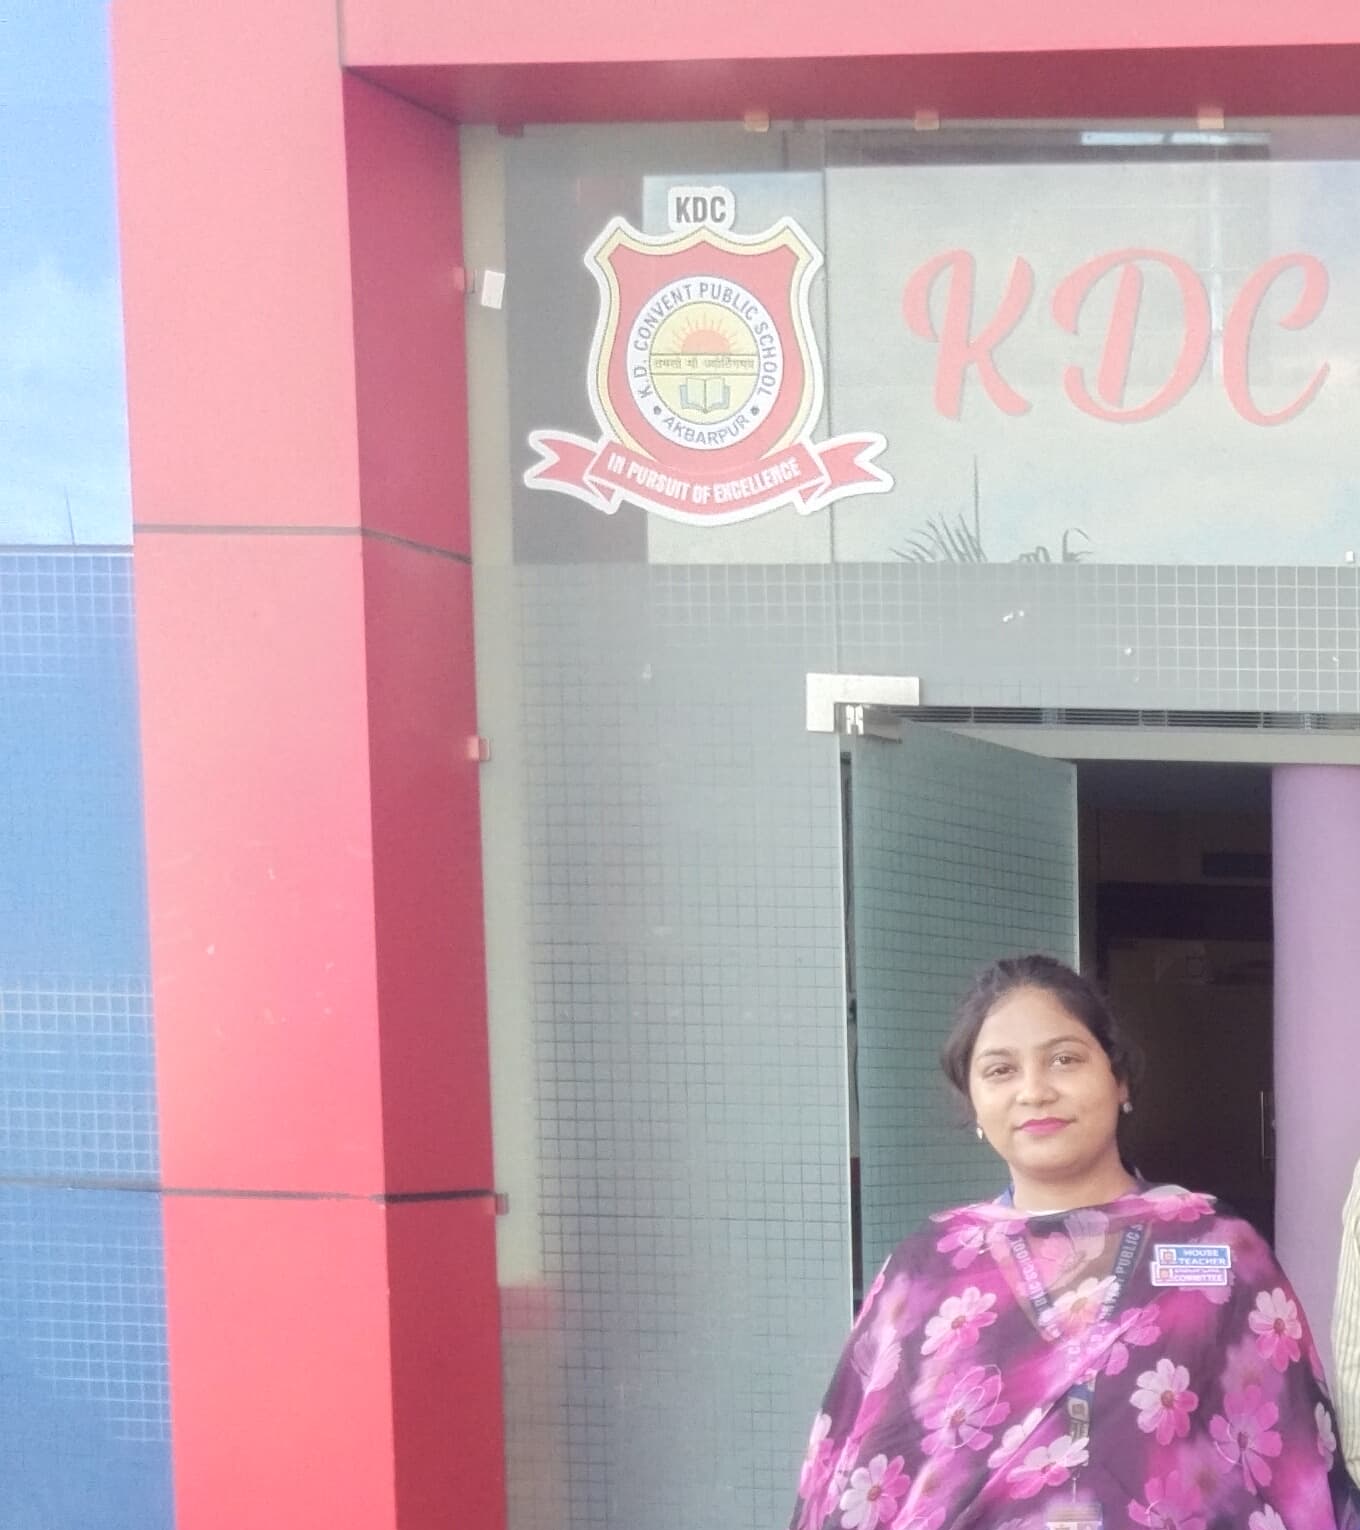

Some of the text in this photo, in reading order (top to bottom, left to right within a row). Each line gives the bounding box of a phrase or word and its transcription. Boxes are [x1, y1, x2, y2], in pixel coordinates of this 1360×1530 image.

[676, 196, 726, 223] KDC
[634, 284, 692, 351] CONVENT
[700, 282, 758, 321] PUBLIC
[754, 321, 778, 397] SCHOOL
[902, 247, 1330, 427] KDC
[662, 414, 750, 446] AKBARPUR
[607, 452, 801, 504] IN PURSUIT OF EXCELLENCE
[1115, 1230, 1141, 1275] PUBLIC
